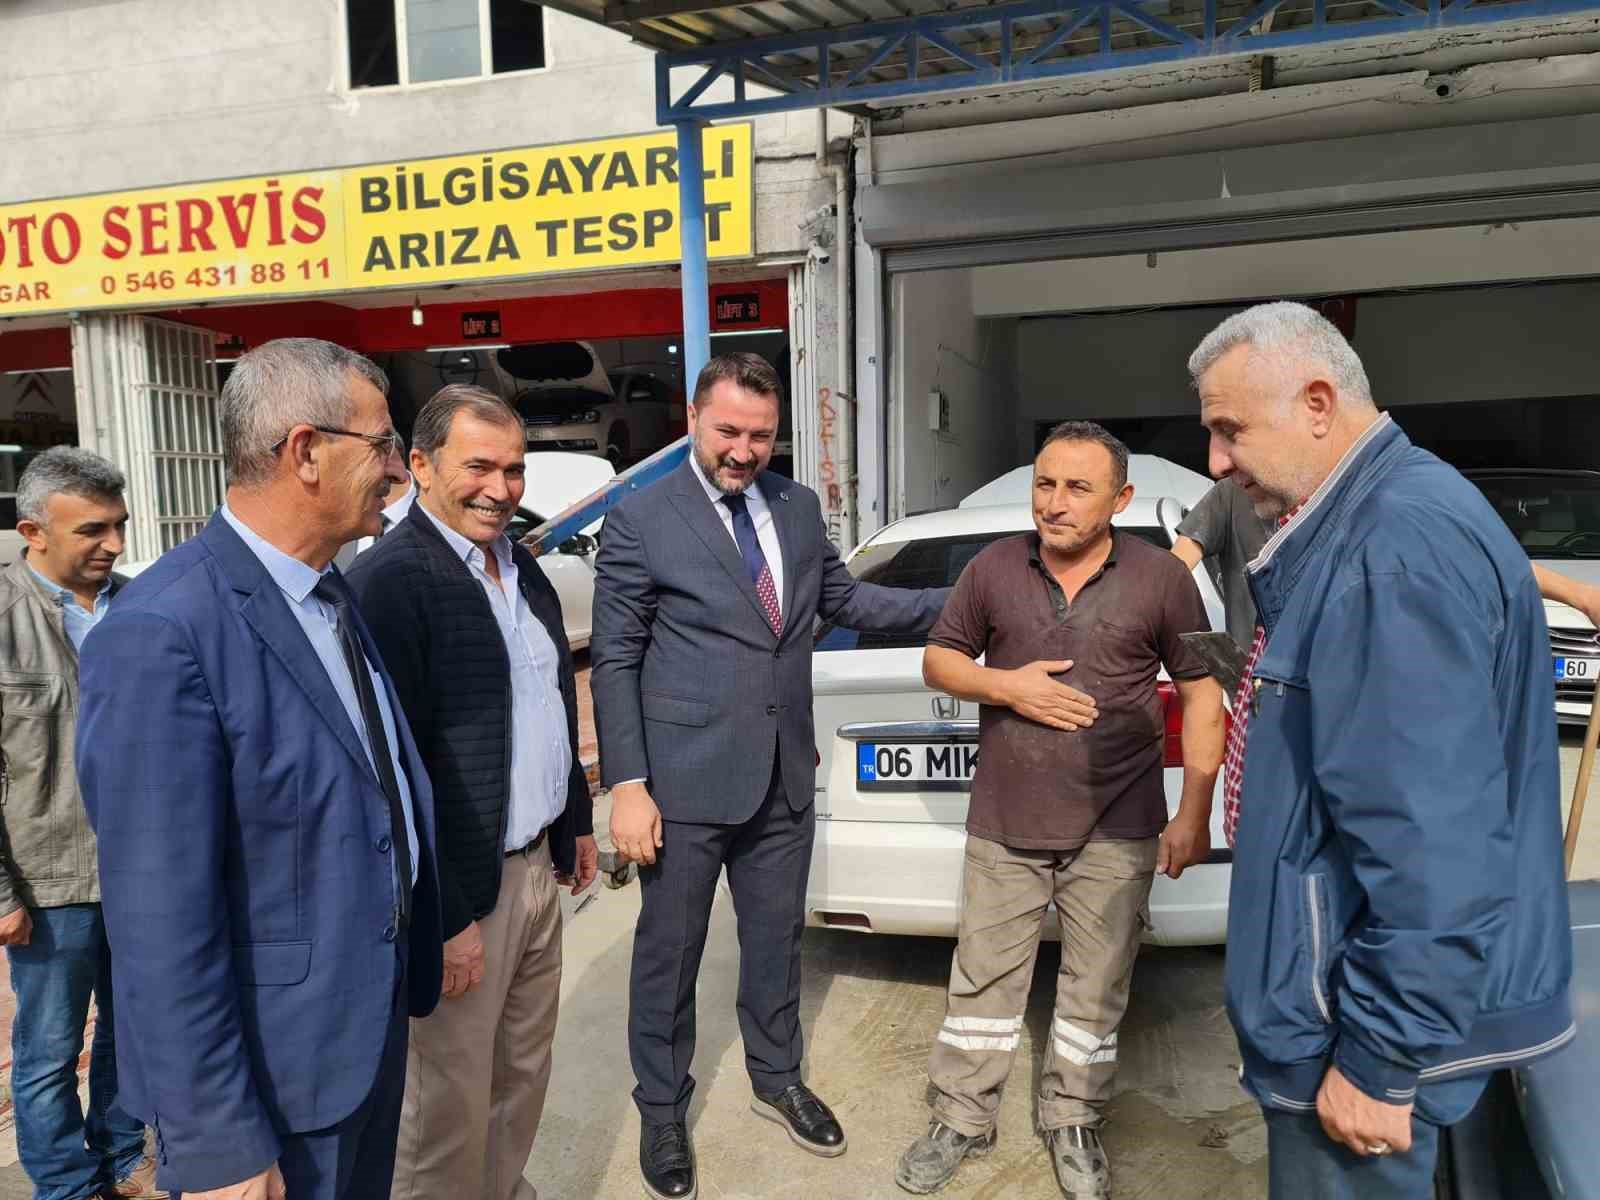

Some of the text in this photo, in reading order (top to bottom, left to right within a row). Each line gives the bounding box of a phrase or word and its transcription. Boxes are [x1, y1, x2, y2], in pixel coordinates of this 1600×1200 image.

[0, 179, 328, 269] TO SERVİS
[363, 202, 732, 273] ARIZA TESPT
[100, 257, 330, 295] 0 546 431 88 11
[1566, 661, 1587, 677] 60
[863, 764, 875, 774] TR
[876, 747, 913, 778] 06
